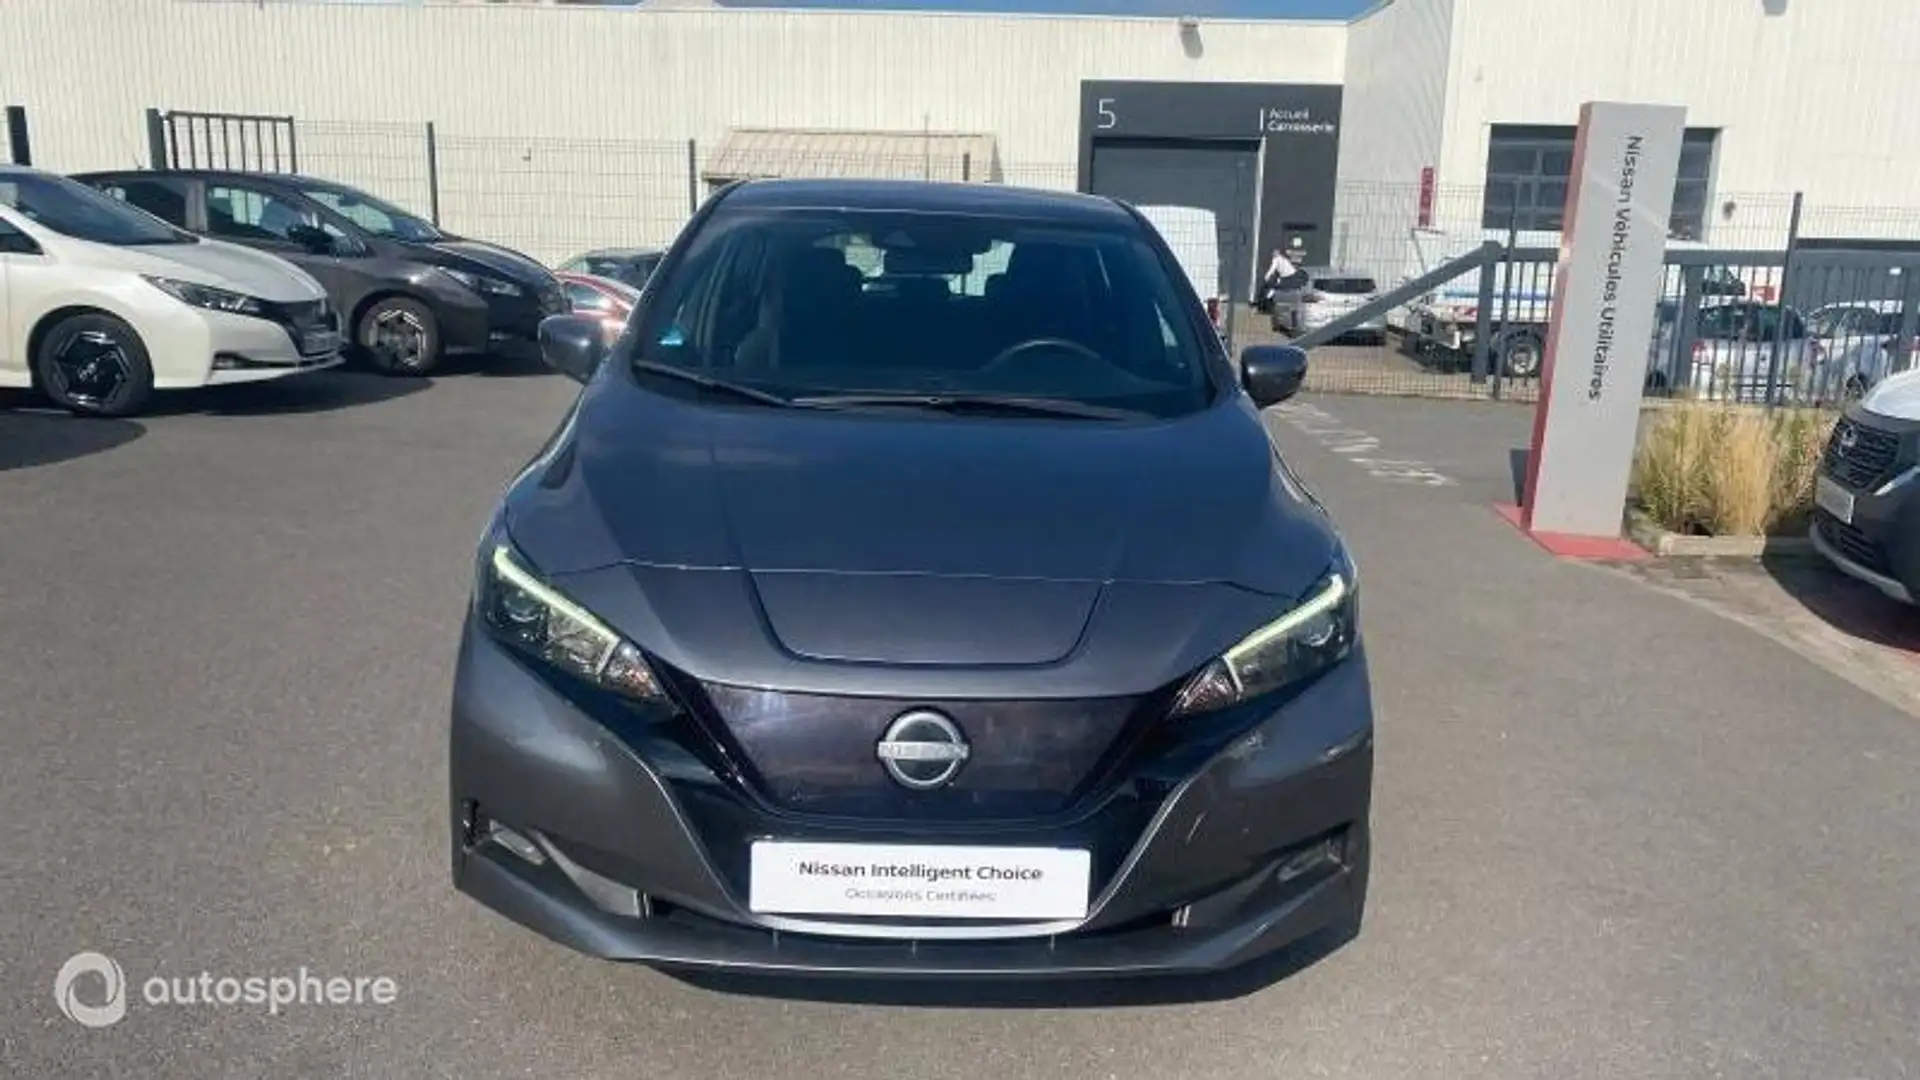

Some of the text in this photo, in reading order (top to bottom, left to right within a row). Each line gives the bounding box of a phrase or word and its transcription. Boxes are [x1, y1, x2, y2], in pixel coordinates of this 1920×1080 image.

[1097, 98, 1117, 130] 5
[1269, 108, 1310, 120] Accueil
[1588, 135, 1644, 400] Nissan Véhicules Utilitaires
[799, 861, 1044, 882] Nissan Intelligent Choice
[845, 887, 922, 901] Occasions
